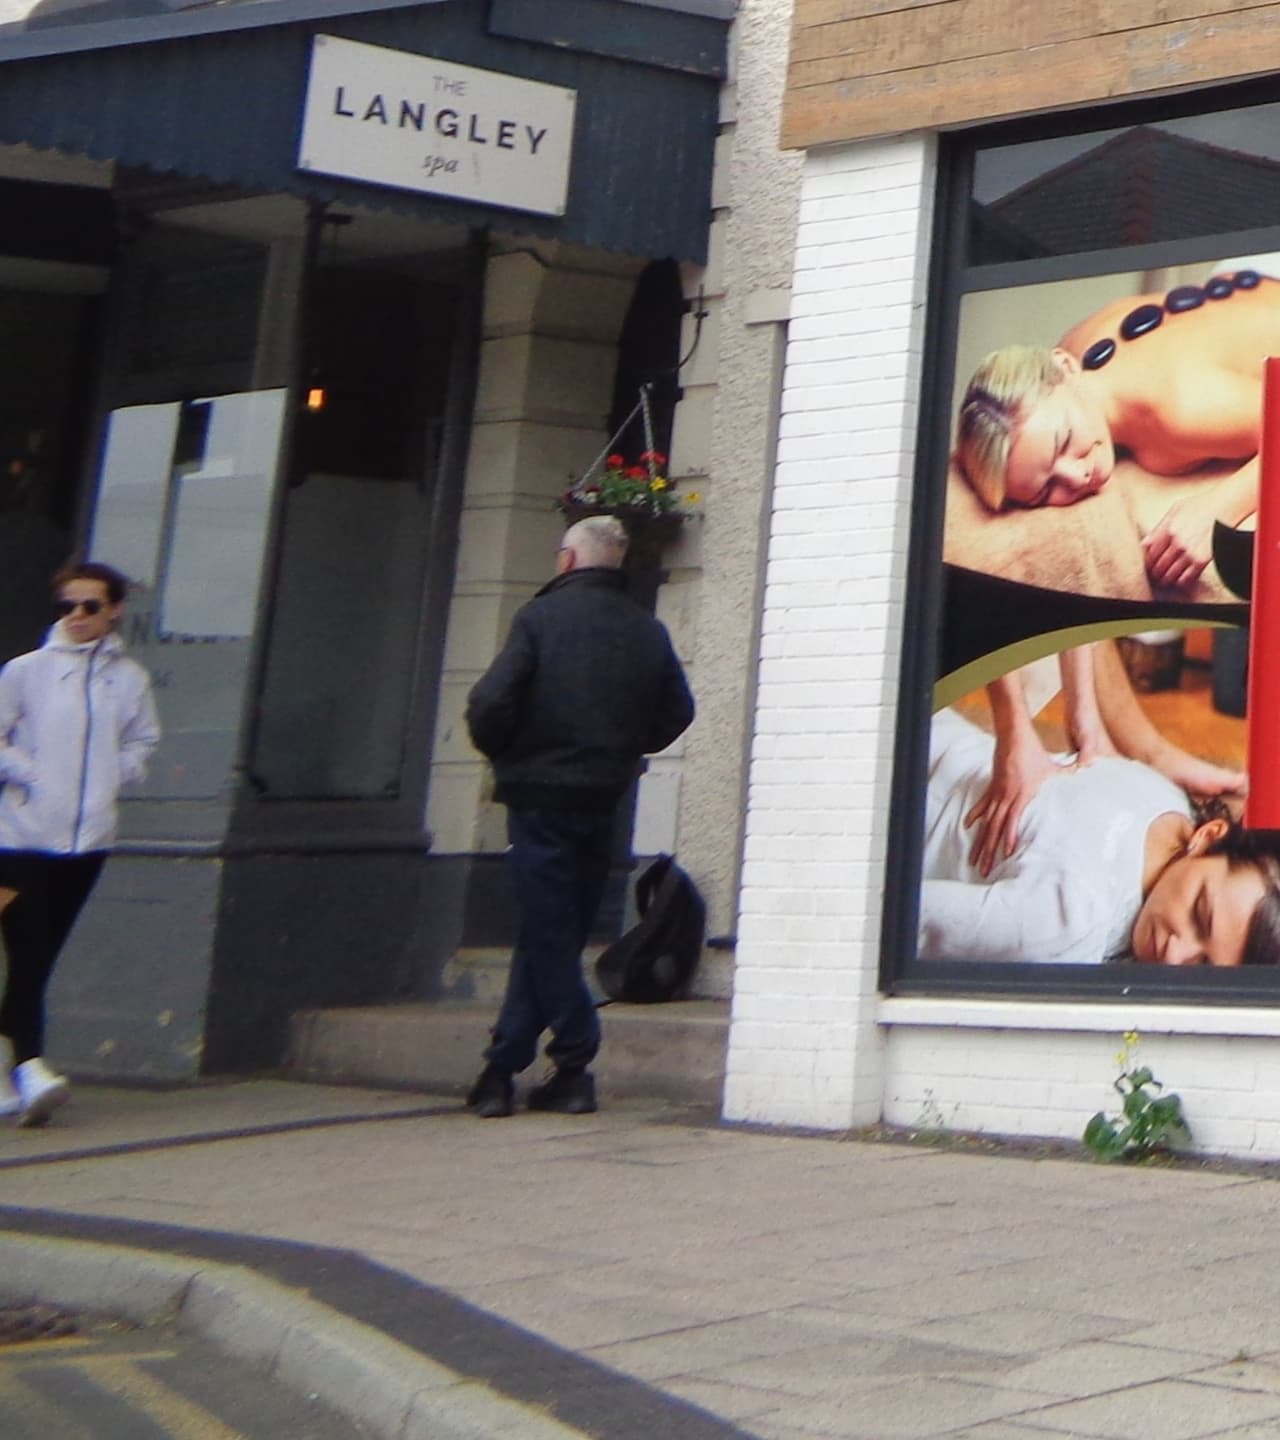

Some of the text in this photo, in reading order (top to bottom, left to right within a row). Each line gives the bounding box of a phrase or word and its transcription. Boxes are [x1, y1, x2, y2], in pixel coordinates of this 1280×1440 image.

[432, 75, 468, 96] THE
[333, 86, 548, 155] LANGLEY
[422, 154, 460, 176] spa
